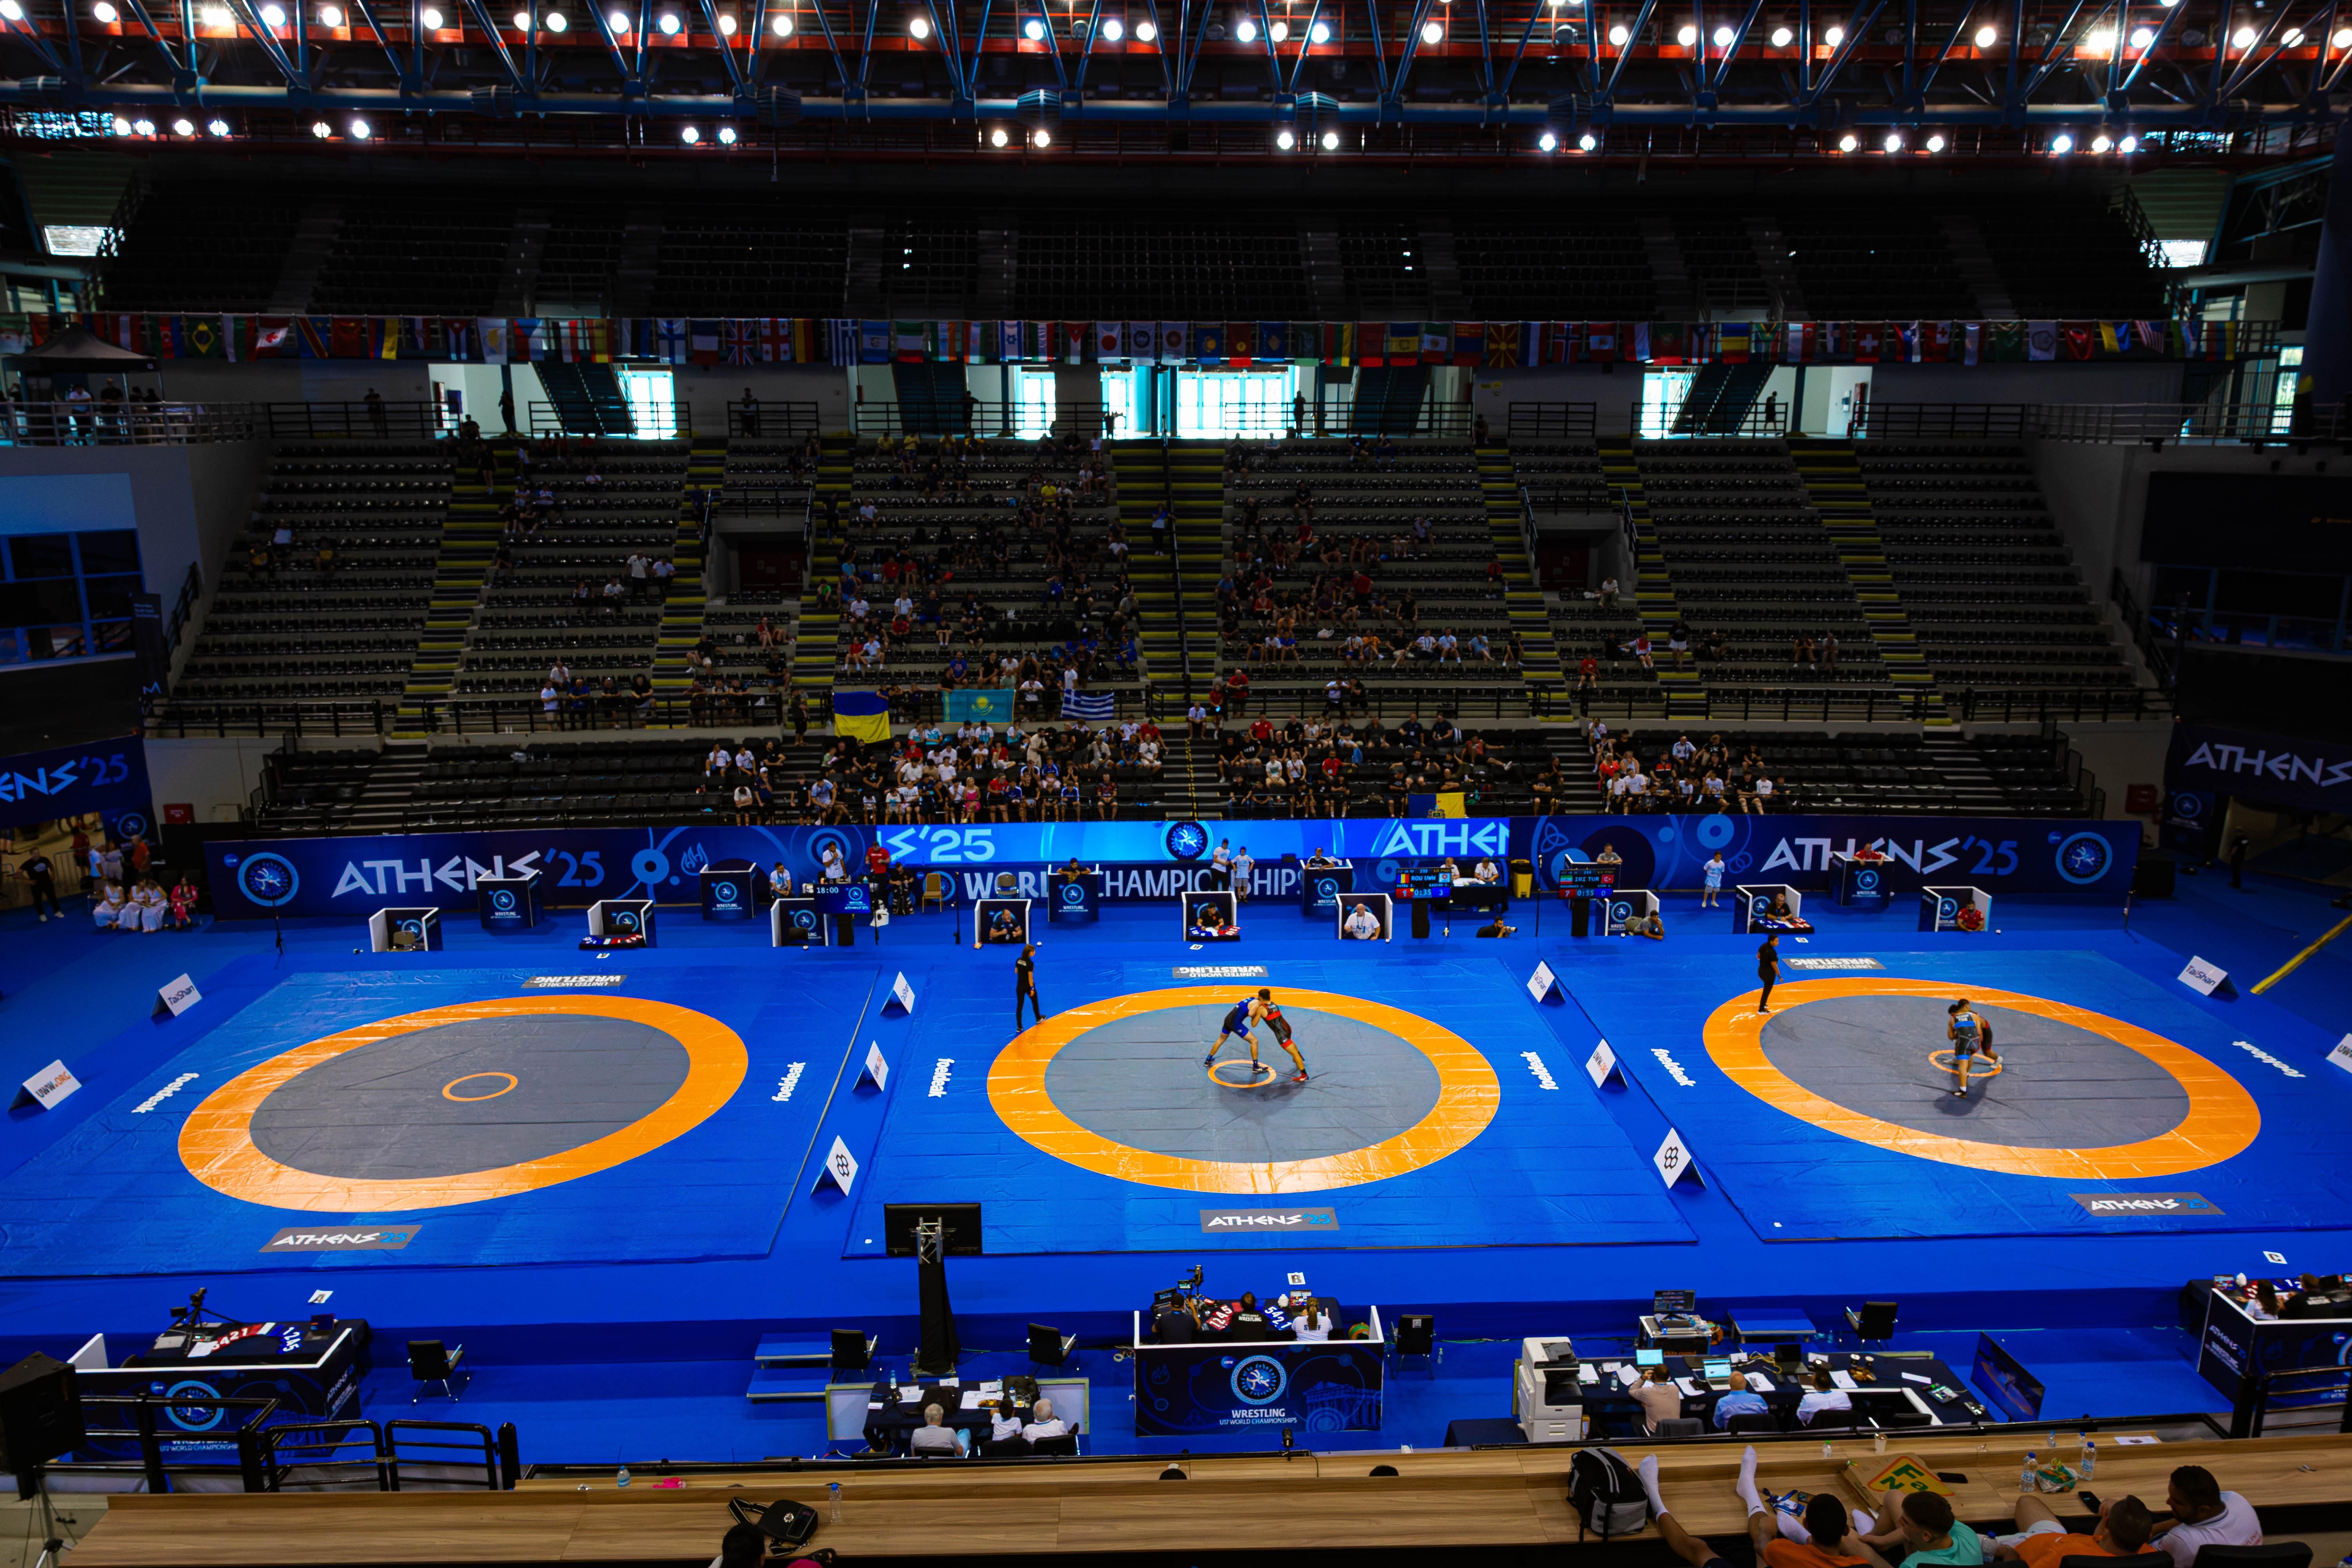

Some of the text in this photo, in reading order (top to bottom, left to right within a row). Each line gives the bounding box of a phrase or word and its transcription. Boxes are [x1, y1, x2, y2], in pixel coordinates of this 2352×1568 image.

[533, 975, 621, 984] WRESTLING
[1520, 1051, 1559, 1090] foeldeak
[1650, 1048, 1697, 1087] foeldeak
[35, 1071, 72, 1099] UWW.ORG
[771, 1062, 807, 1102] foeldeak
[927, 1058, 955, 1098] foeldeak
[131, 1072, 200, 1114] foeldeak
[1291, 1275, 1302, 1283] B
[1216, 1311, 1229, 1319] 4
[1221, 1305, 1233, 1314] 5
[1265, 1306, 1277, 1314] 5
[1272, 1316, 1285, 1325] 2
[1209, 1320, 1221, 1328] 1
[220, 1336, 230, 1345] 4
[229, 1331, 240, 1340] 2
[241, 1328, 249, 1336] 1
[1232, 1408, 1286, 1418] WRESTLING
